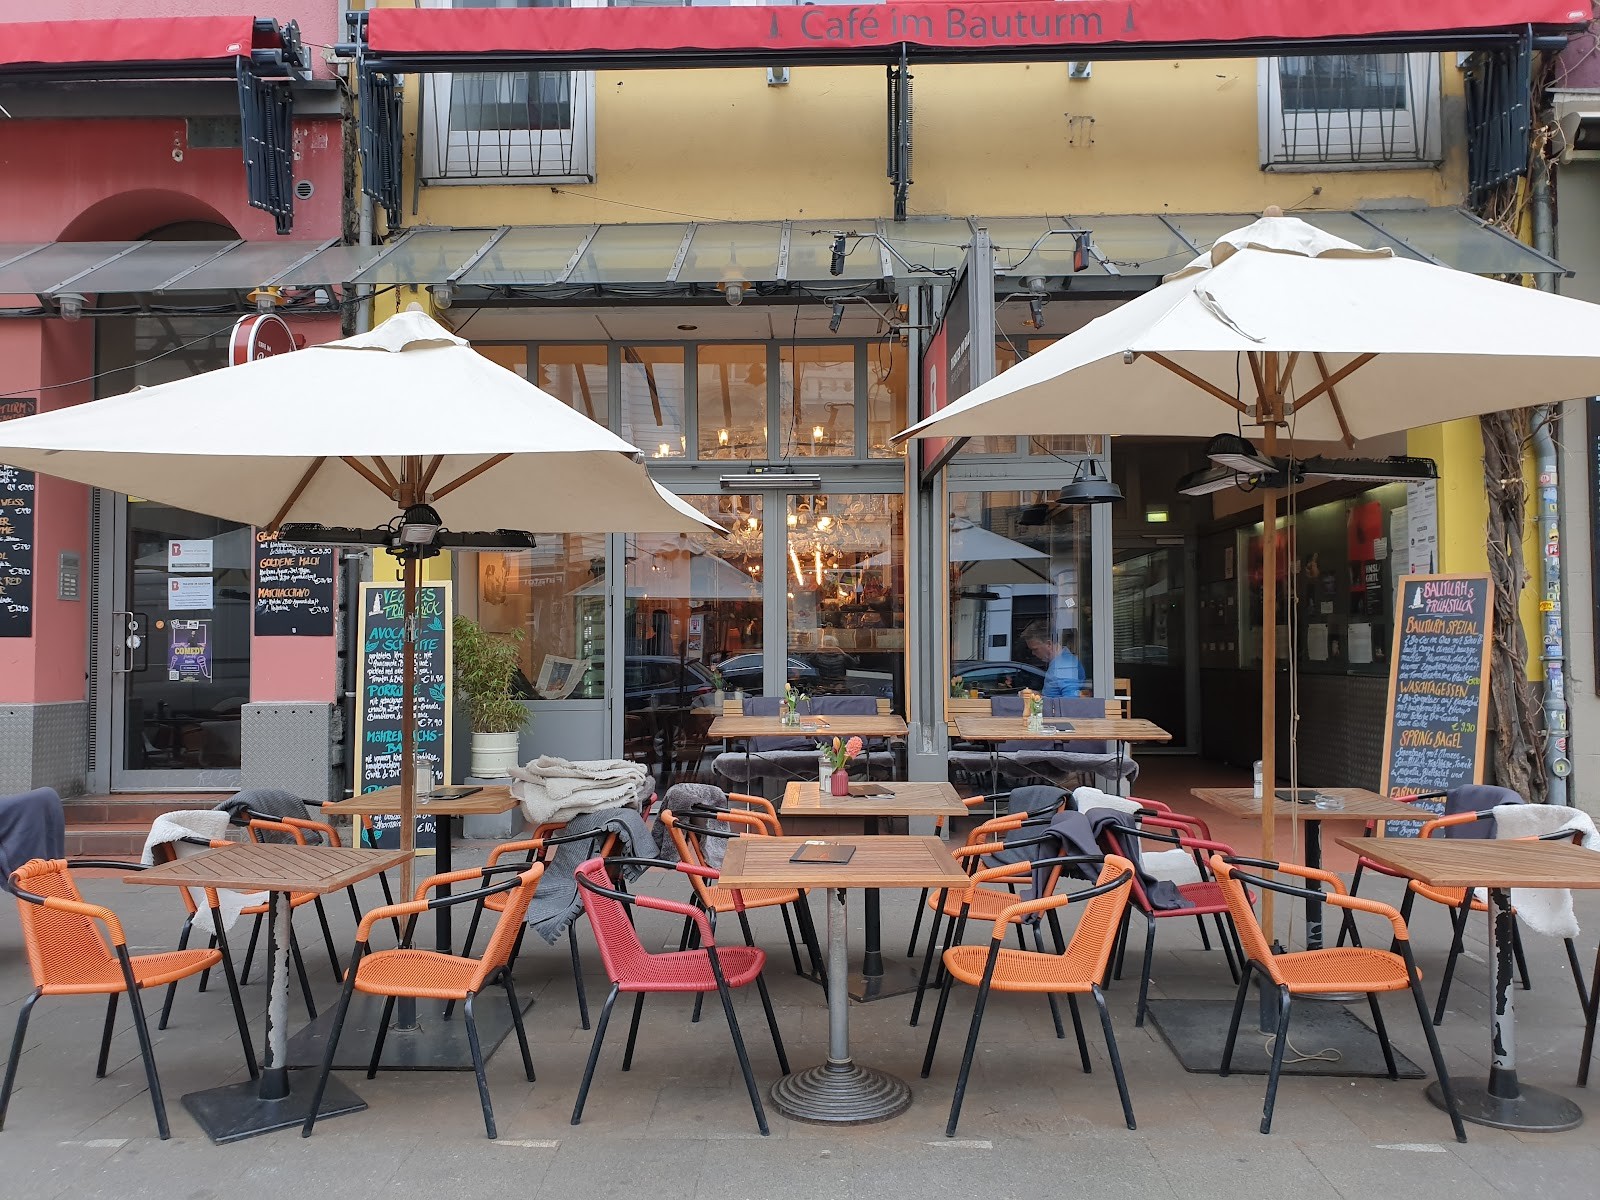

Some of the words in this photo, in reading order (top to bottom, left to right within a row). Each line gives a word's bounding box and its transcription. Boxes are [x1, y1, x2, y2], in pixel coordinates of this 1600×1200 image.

[800, 8, 879, 40] Café
[891, 9, 933, 38] im
[946, 9, 1102, 39] Bauturm
[1426, 598, 1476, 614] FRÜHSTÜCK
[1446, 620, 1479, 634] SPEZIAL
[367, 684, 422, 697] PORRIE
[1400, 680, 1468, 698] WASCHTAGESSEN
[1400, 730, 1432, 748] SPRING
[1433, 731, 1462, 749] BAGEL
